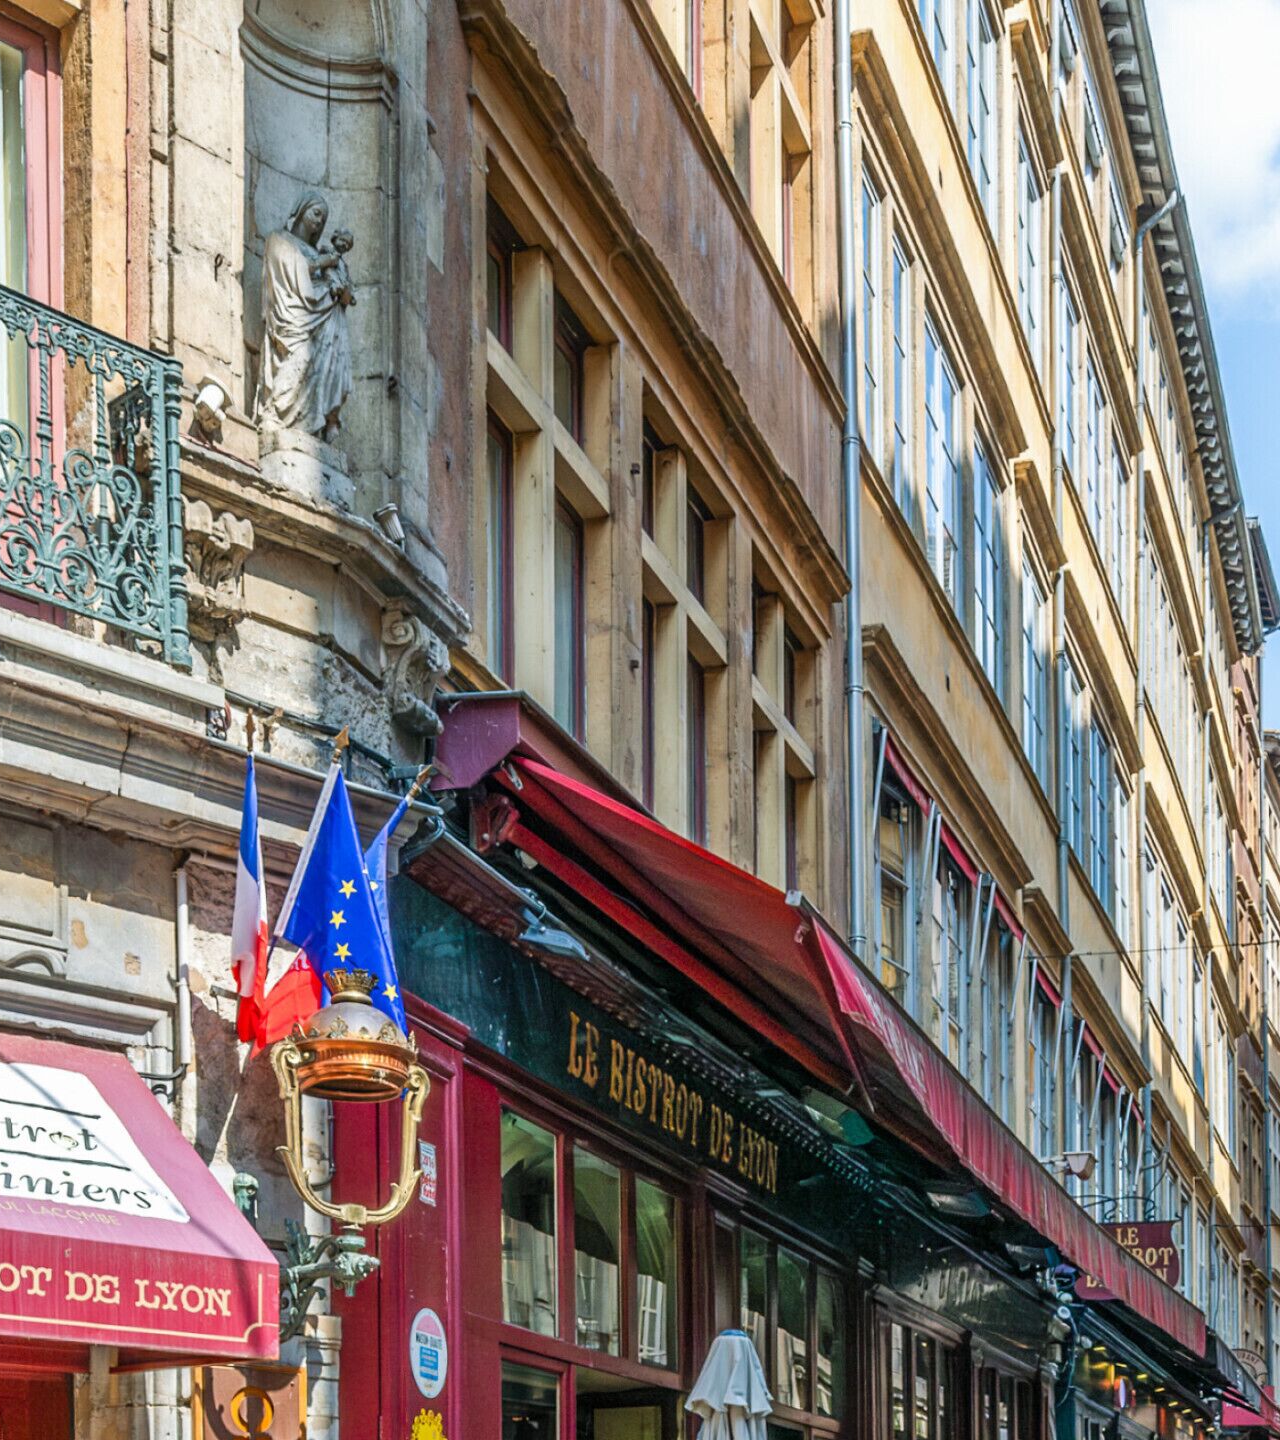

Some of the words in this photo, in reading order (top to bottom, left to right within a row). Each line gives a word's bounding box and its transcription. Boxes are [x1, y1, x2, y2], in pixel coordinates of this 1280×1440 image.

[566, 1011, 600, 1088] LE
[609, 1039, 702, 1148] BISTROT
[710, 1104, 734, 1162] DE
[738, 1123, 778, 1193] LYON
[31, 1204, 120, 1226] LACOMBE
[1116, 1227, 1139, 1245] LE
[65, 1270, 120, 1305] DE
[134, 1279, 232, 1317] LYON
